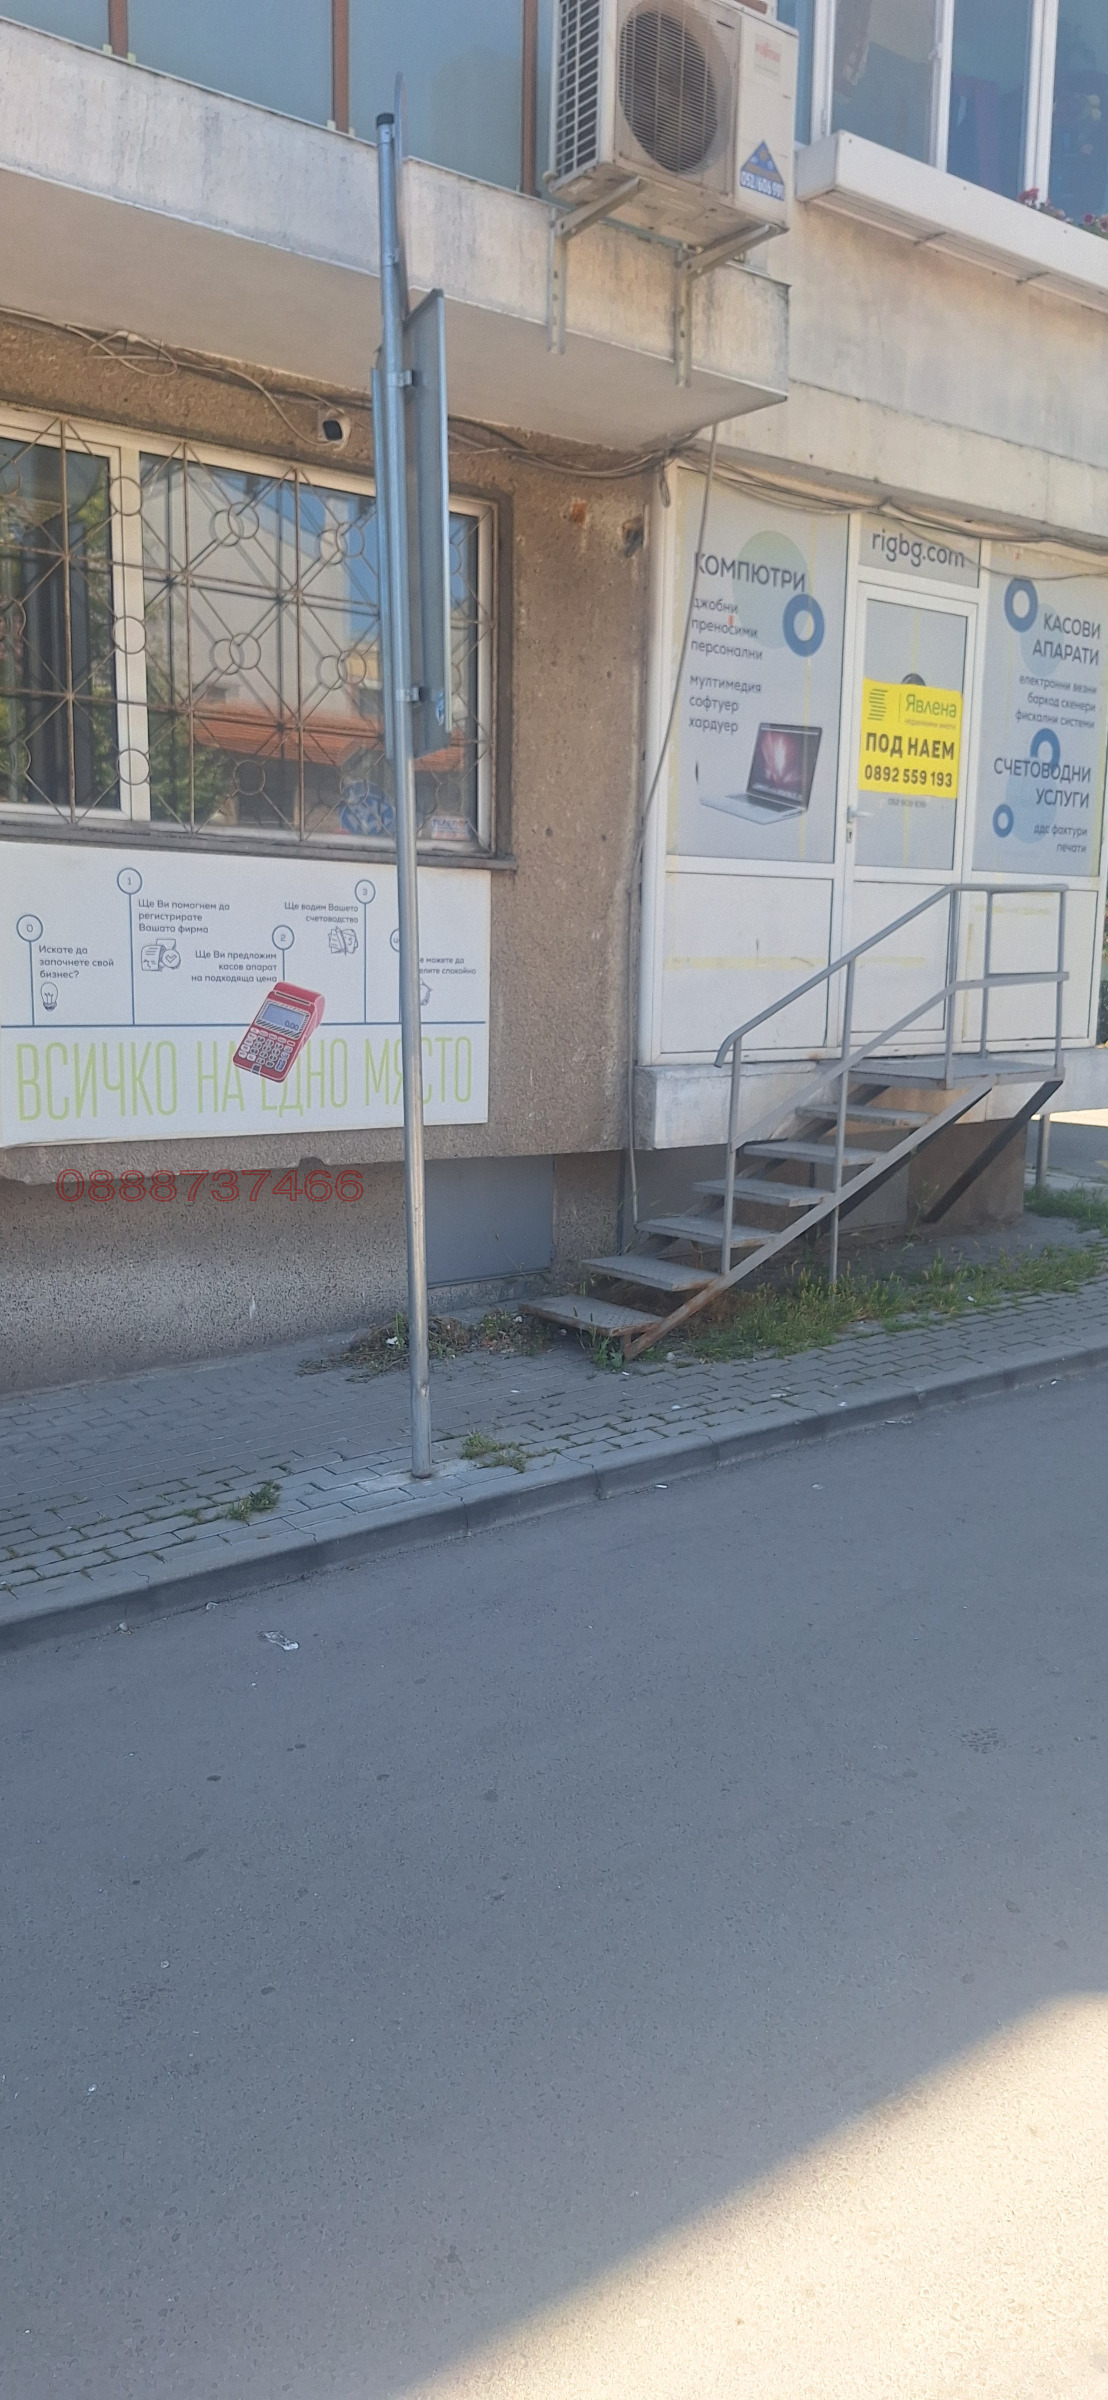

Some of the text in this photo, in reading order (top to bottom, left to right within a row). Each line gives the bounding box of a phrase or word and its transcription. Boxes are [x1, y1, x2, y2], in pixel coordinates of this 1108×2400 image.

[871, 529, 965, 568] rigbg.com
[695, 553, 805, 592] КОМПЮТРИ
[692, 619, 758, 639] преносими
[1043, 612, 1100, 640] КАСОВИ
[691, 641, 763, 661] персонални
[1032, 640, 1099, 667] АПАРАТИ
[689, 675, 762, 694] мултимедия
[1019, 675, 1071, 691] електронни
[689, 696, 739, 715] софтуер
[905, 693, 957, 719] Явлена
[1061, 699, 1096, 714] скенери
[688, 717, 739, 736] хардуер
[1015, 708, 1095, 729] фискални системи
[865, 732, 955, 761] ПОД НАЕМ
[864, 764, 953, 788] 0892 559 193
[994, 757, 1091, 785] СЧЕТОВОДНИ
[1036, 788, 1090, 809] УСЛУГИ
[1051, 826, 1088, 839] фактури
[1056, 843, 1087, 854] печати
[138, 900, 231, 911] Ще Ви помогнем да
[284, 901, 300, 911] Ще
[328, 903, 359, 913] Вашето
[138, 912, 203, 923] регистрирате
[305, 915, 359, 924] счетоводство
[139, 923, 209, 935] Вашата фирма
[280, 933, 287, 942] 2
[38, 945, 88, 956] Искате да
[195, 950, 277, 961] Ще Ви предложим
[39, 959, 115, 967] започнете свой
[218, 963, 278, 973] касов апарат
[454, 957, 465, 965] да
[39, 970, 80, 979] бизнес?
[441, 967, 477, 975] спокойно
[204, 975, 255, 983] подходяща
[256, 976, 278, 984] цена
[16, 1040, 178, 1121] ВСИЧКО
[197, 1040, 246, 1114] НА
[56, 1169, 365, 1202] 0888737466
